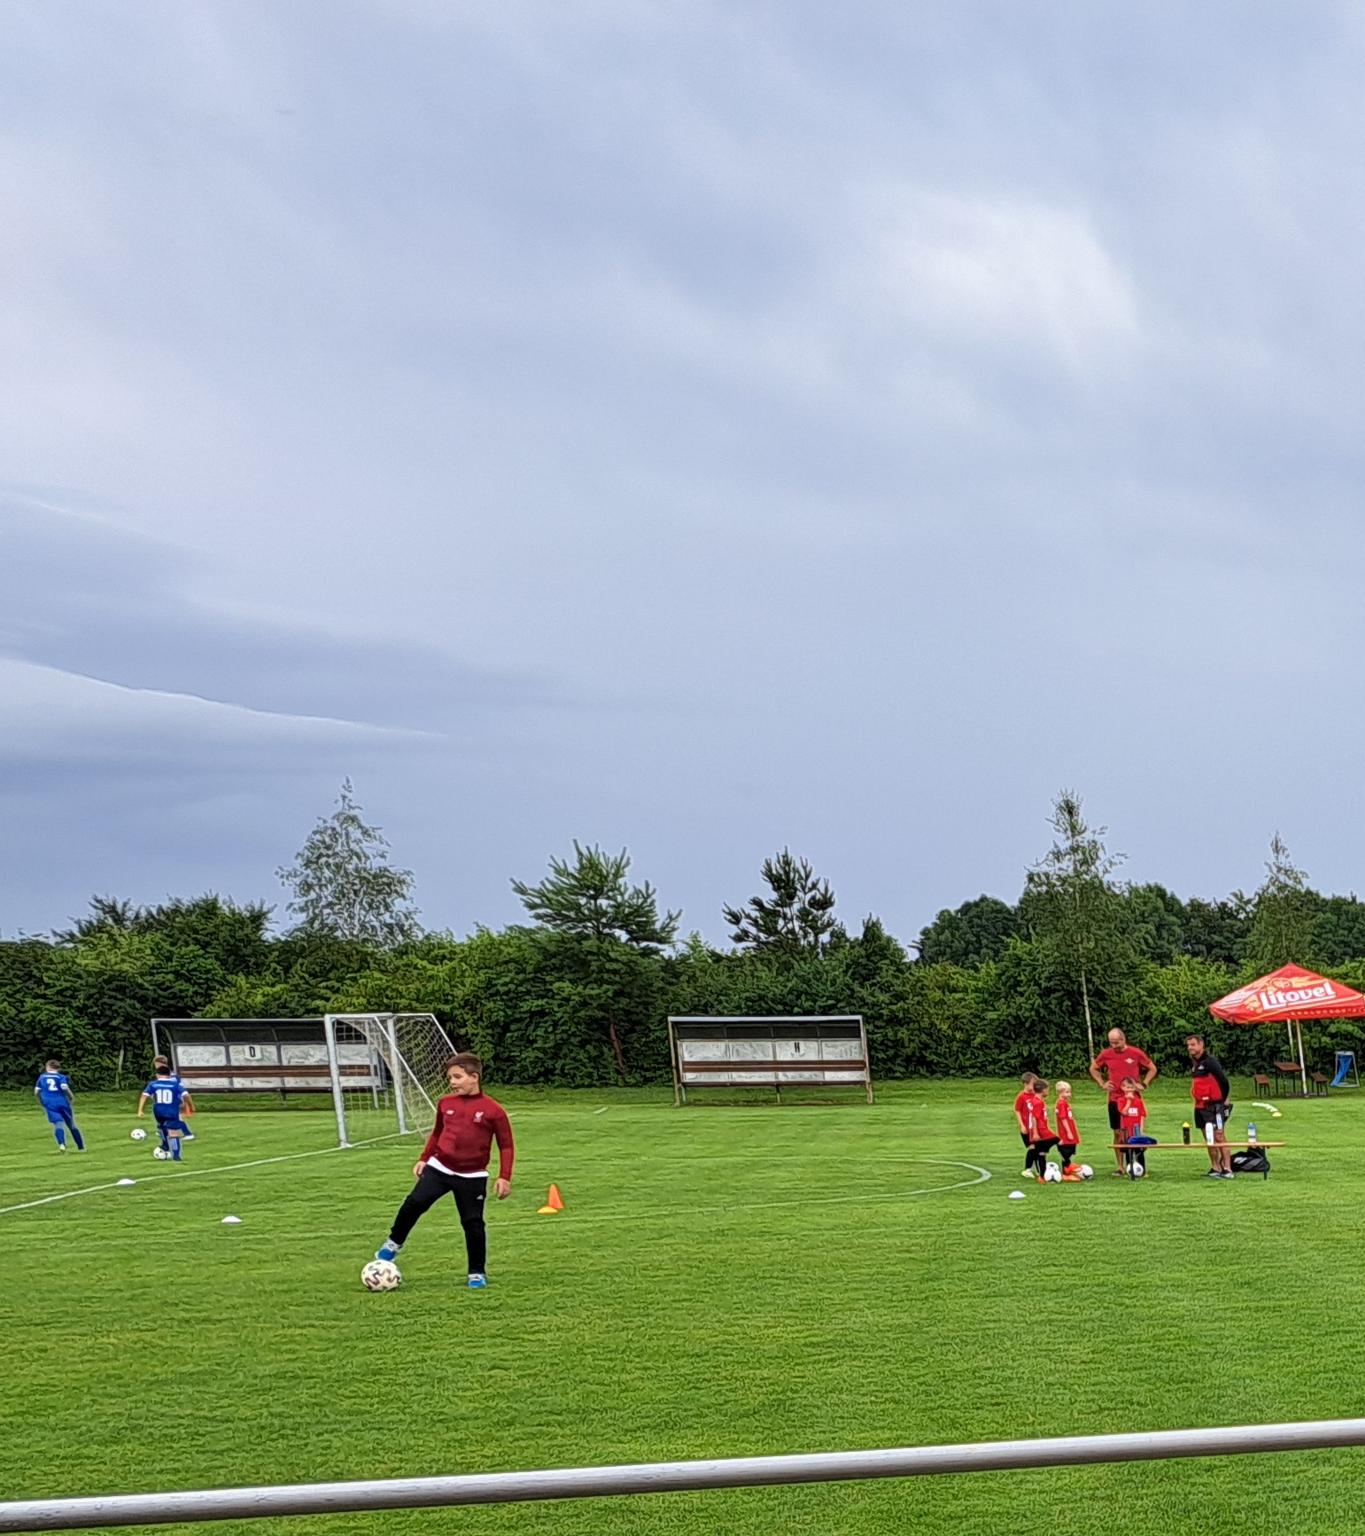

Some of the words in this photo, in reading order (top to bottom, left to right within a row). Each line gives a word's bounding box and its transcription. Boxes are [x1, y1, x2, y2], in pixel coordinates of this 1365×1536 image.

[1259, 981, 1336, 1010] Litovel
[46, 1079, 58, 1091] 2
[155, 1089, 173, 1104] 10
